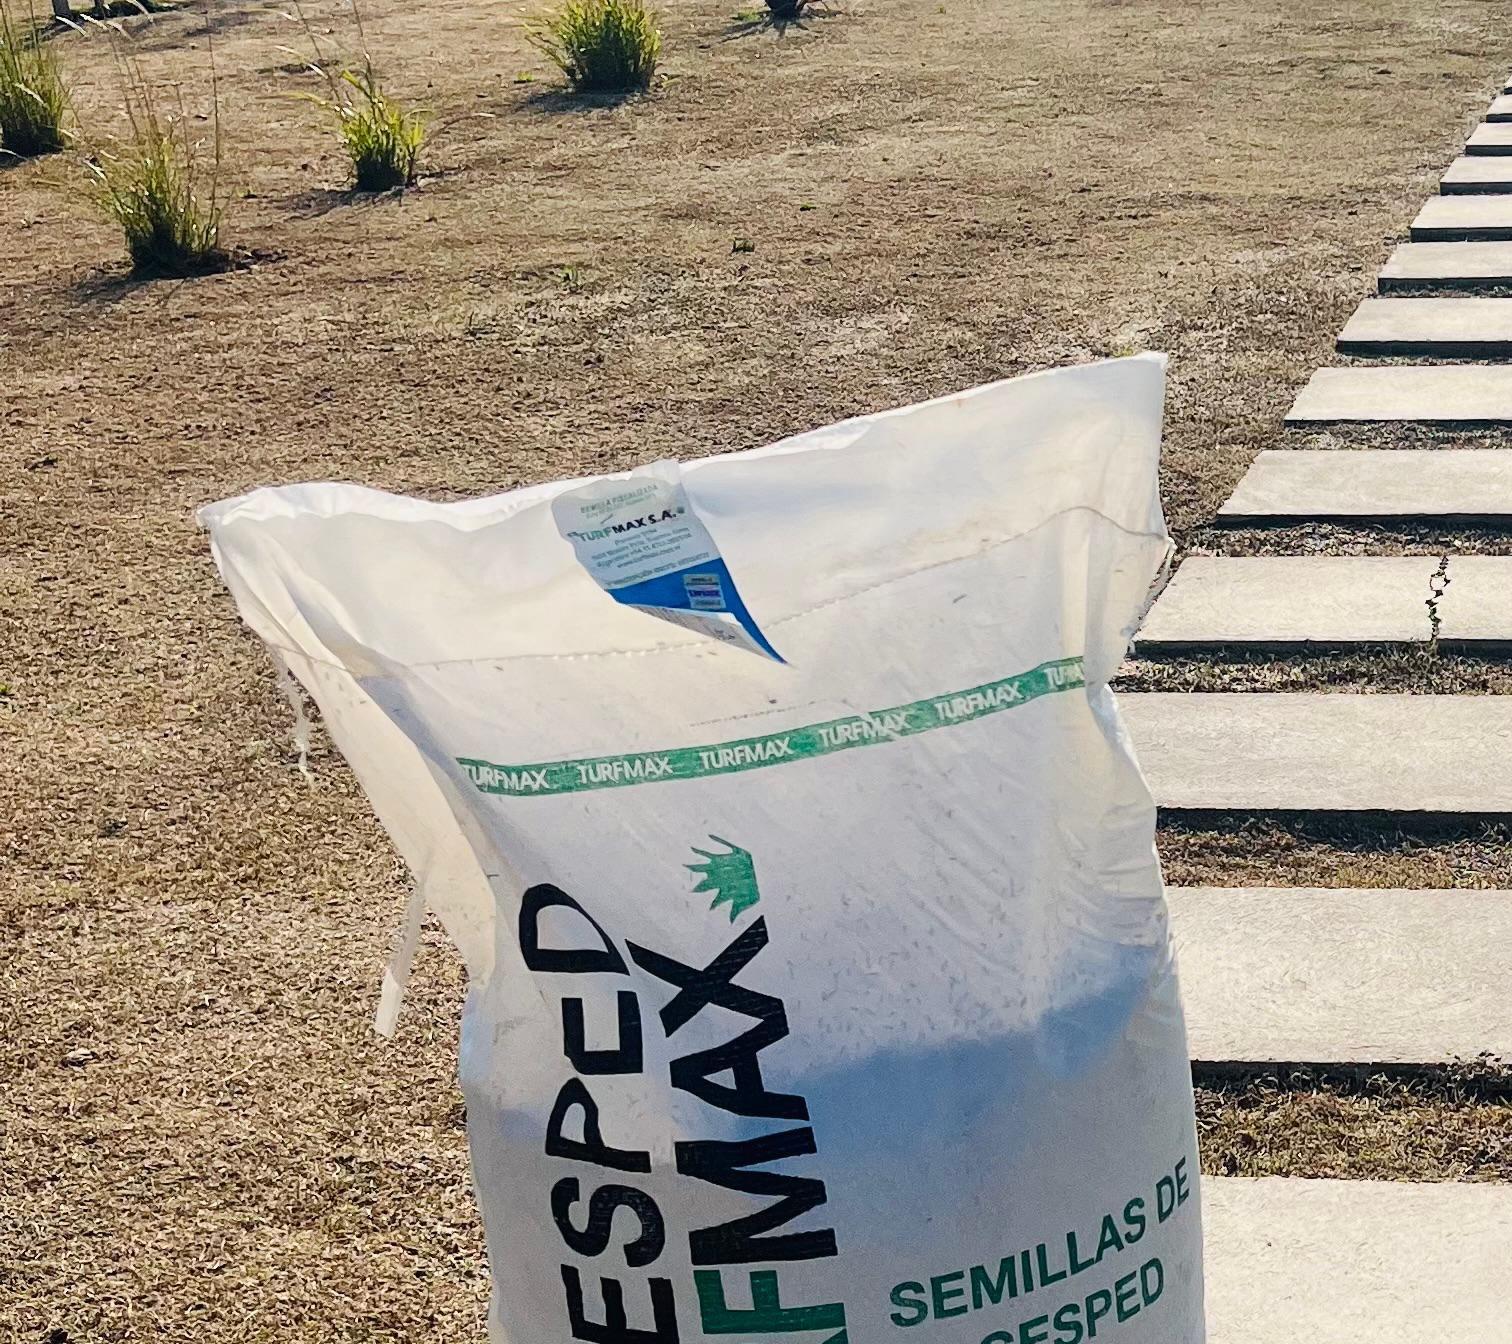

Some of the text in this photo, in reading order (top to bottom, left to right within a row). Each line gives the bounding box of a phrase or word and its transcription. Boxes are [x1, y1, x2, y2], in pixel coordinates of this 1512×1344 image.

[578, 517, 648, 542] TURFMAX
[648, 509, 677, 525] S.A.
[463, 680, 1025, 791] TURFMAX TURFMAX TURFMAX TURFMAX TURFMAX
[889, 1156, 1190, 1327] SEMILLAS DE
